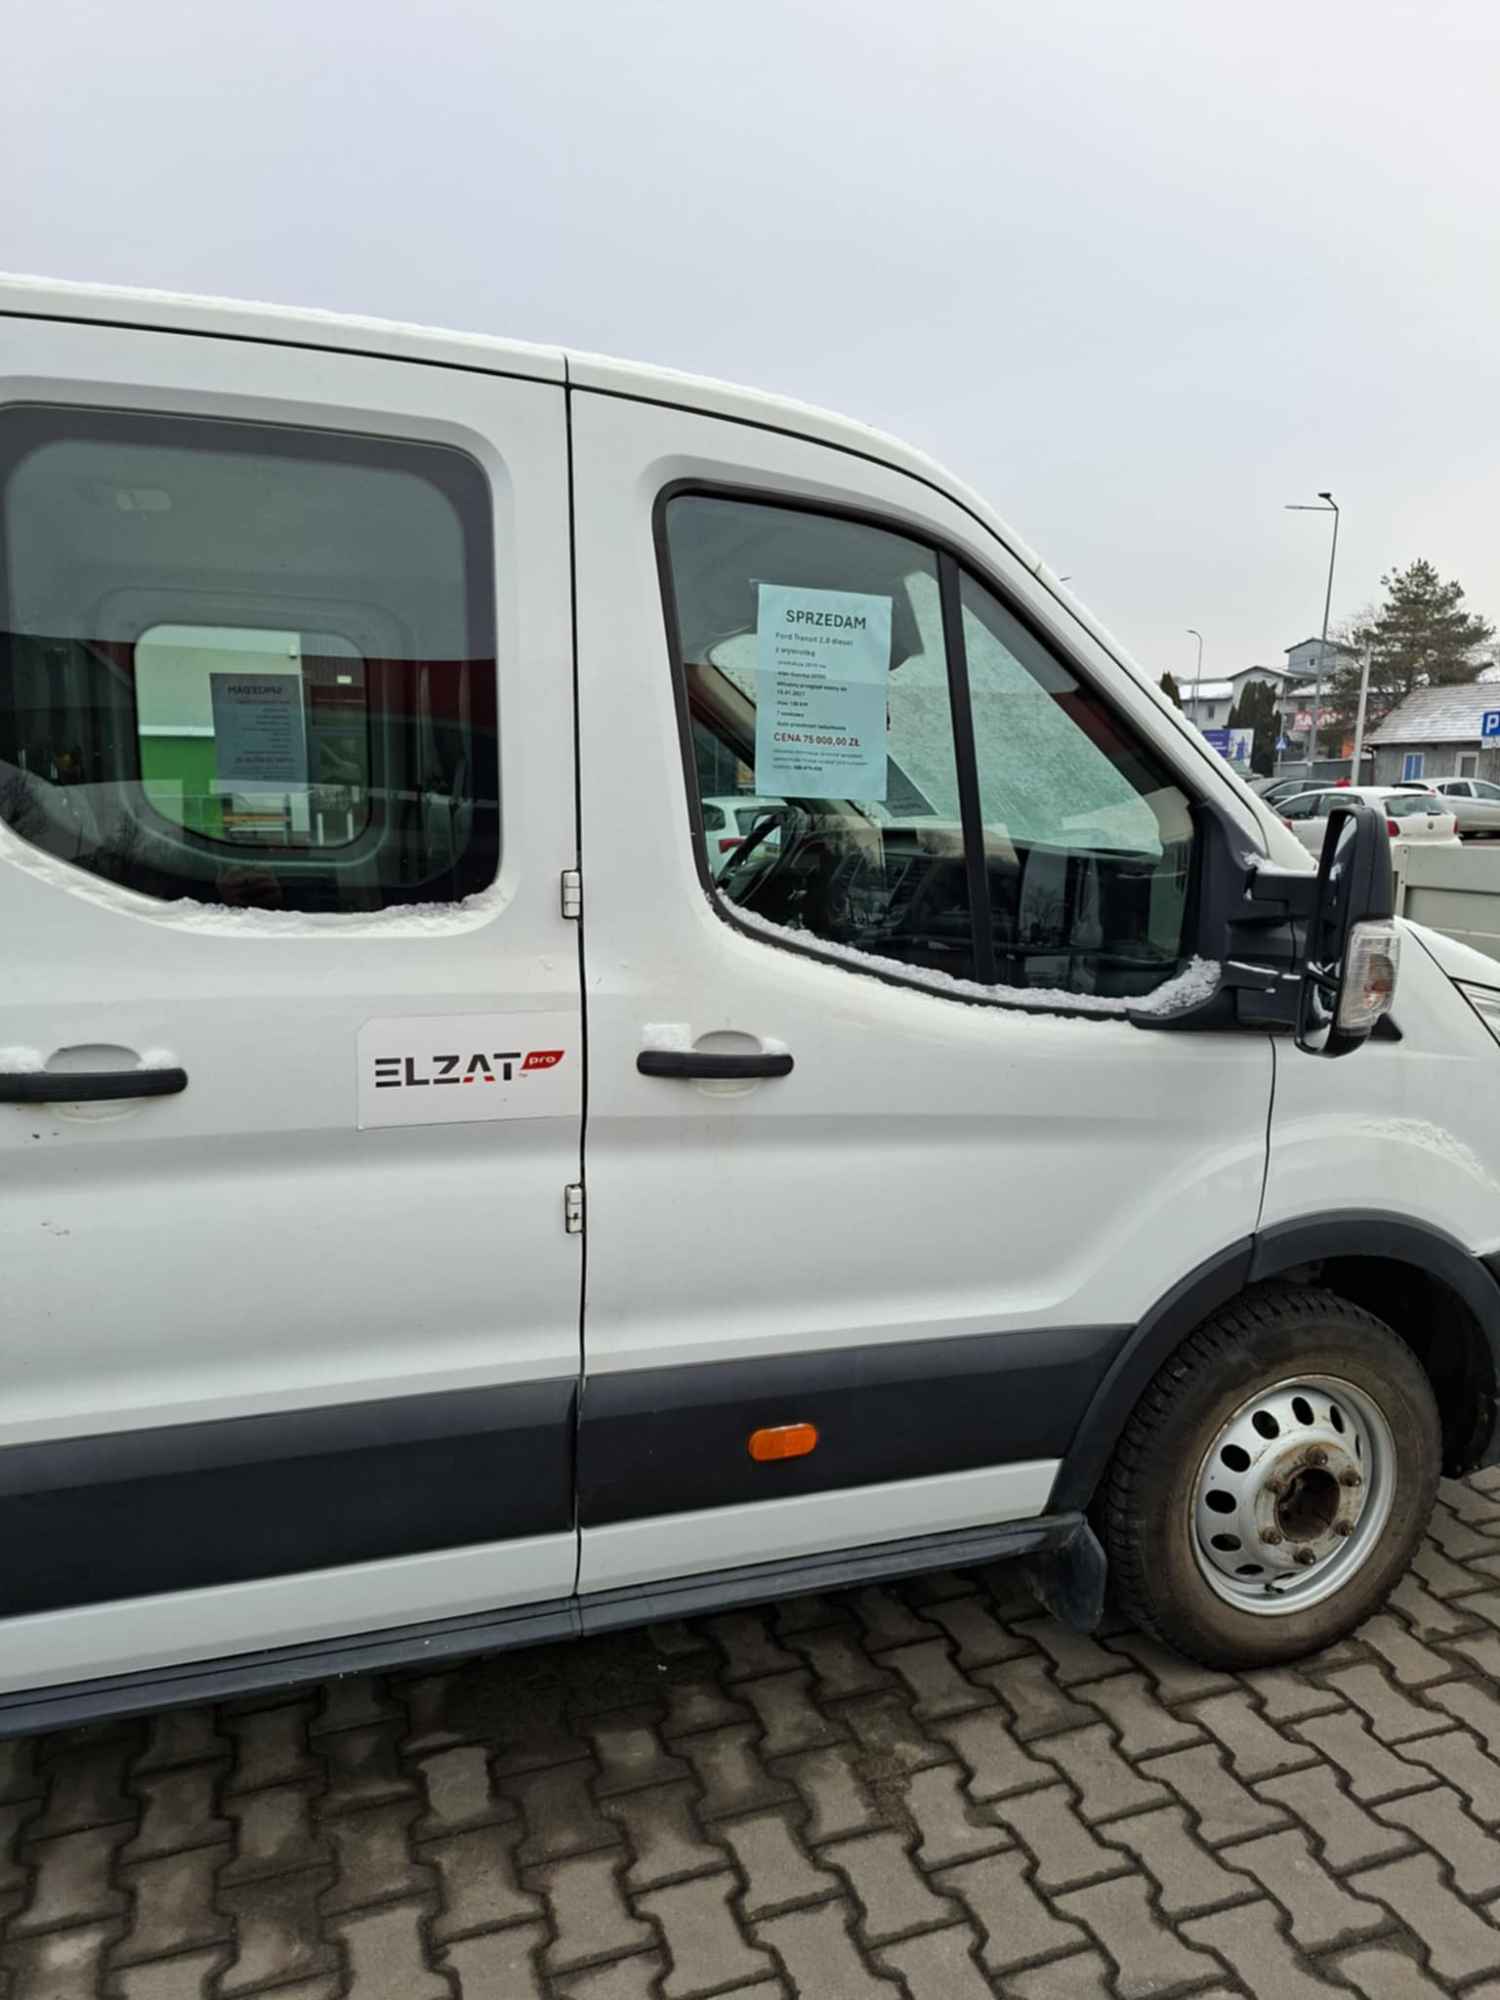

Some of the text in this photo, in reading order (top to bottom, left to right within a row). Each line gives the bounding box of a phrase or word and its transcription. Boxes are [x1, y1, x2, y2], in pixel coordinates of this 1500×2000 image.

[785, 610, 867, 630] SPRZEDAM
[775, 632, 793, 641] Ford
[1485, 714, 1500, 734] P
[773, 732, 801, 744] CENA
[803, 735, 815, 745] 75
[815, 736, 846, 747] 000,00
[375, 1052, 557, 1087] ELZAT pro
